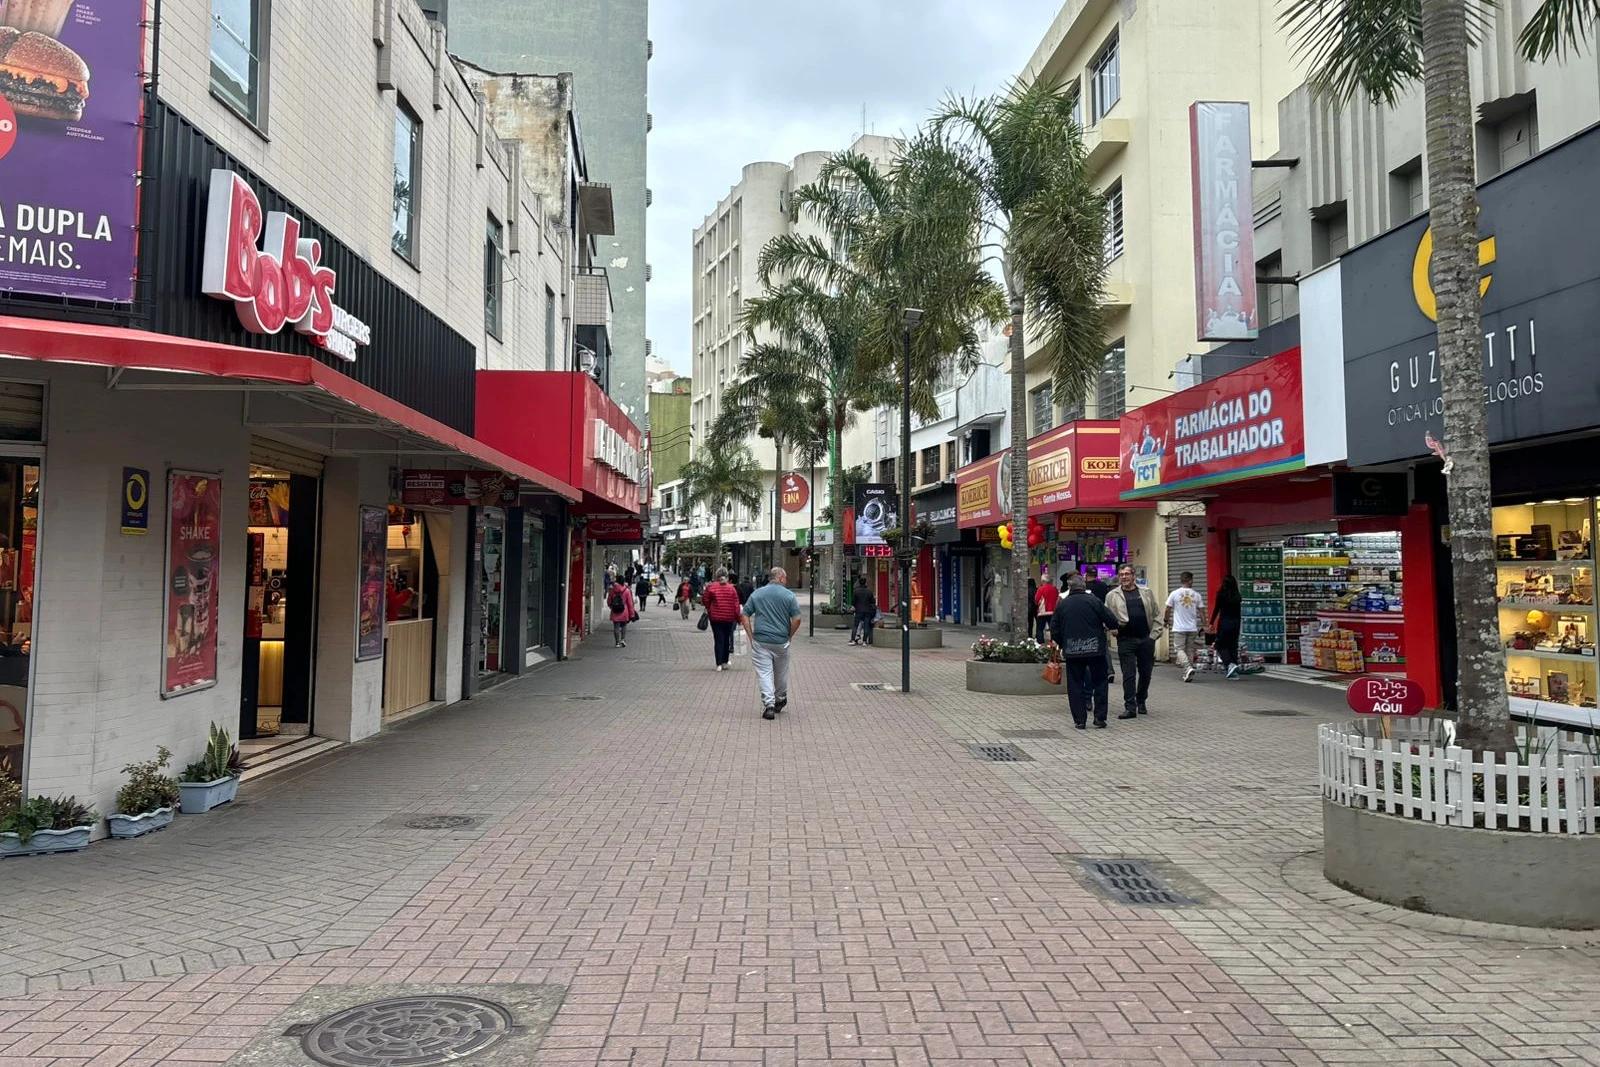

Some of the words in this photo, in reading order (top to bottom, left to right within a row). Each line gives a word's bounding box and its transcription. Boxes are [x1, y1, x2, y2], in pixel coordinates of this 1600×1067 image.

[17, 203, 112, 242] DUPLA
[206, 169, 336, 335] Bob's
[1390, 319, 1536, 393] GUZTTI
[1483, 372, 1544, 404] ELOGIOS
[1174, 397, 1245, 440] FARMÁCIA
[1248, 387, 1272, 416] DO
[1174, 418, 1285, 468] TRABALHADOR
[1137, 461, 1158, 483] FCT
[180, 526, 211, 540] SHAKE
[1367, 680, 1408, 701] Bob's
[1372, 702, 1403, 713] AQUI
